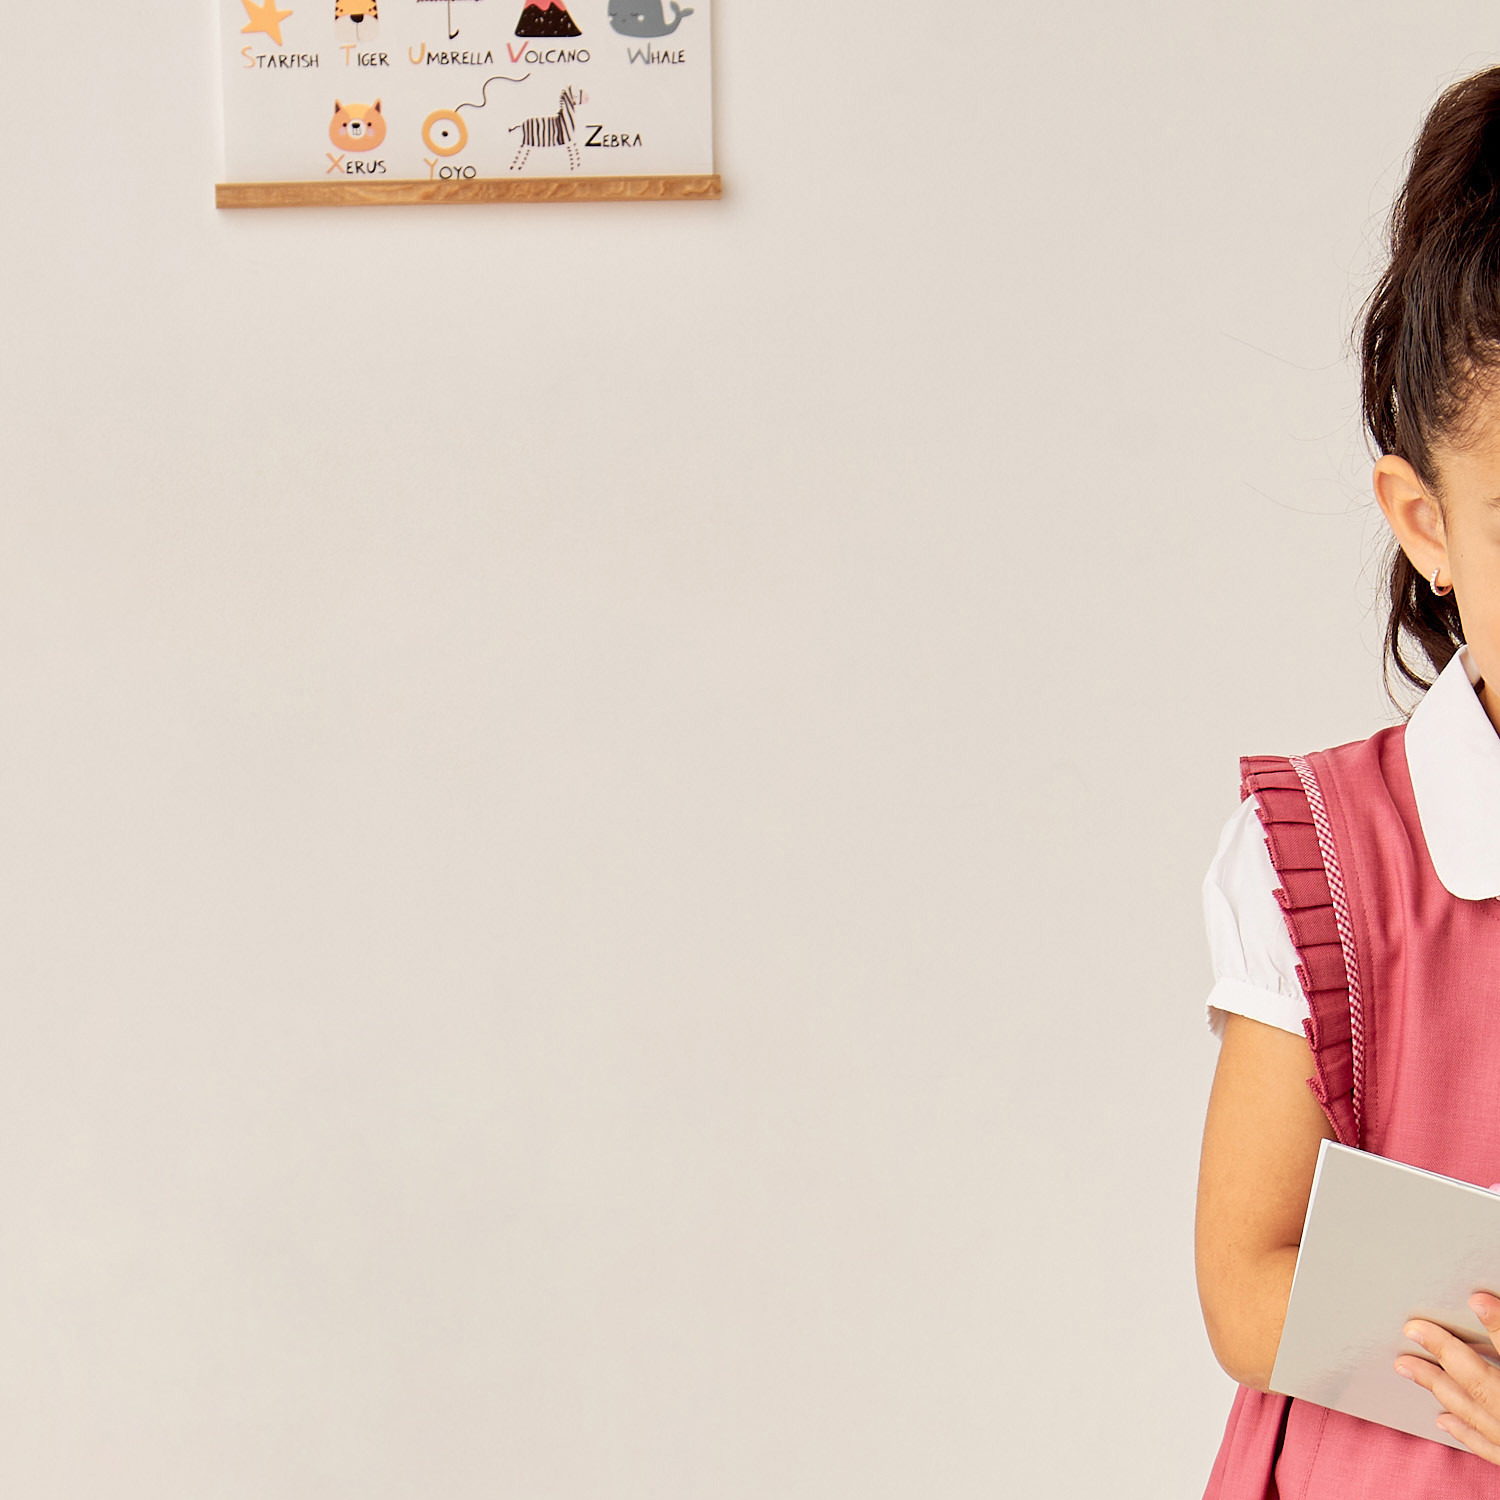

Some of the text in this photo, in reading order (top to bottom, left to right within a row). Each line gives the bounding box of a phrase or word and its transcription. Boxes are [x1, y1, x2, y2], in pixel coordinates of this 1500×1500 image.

[240, 45, 320, 69] STARFISH
[339, 43, 390, 67] TIGER
[408, 42, 494, 66] UMBRELLA
[506, 40, 591, 64] VOLCANO
[627, 42, 686, 65] WHALE
[584, 124, 643, 148] ZEBRA
[326, 152, 387, 175] XERUS
[423, 157, 477, 180] YOYO
